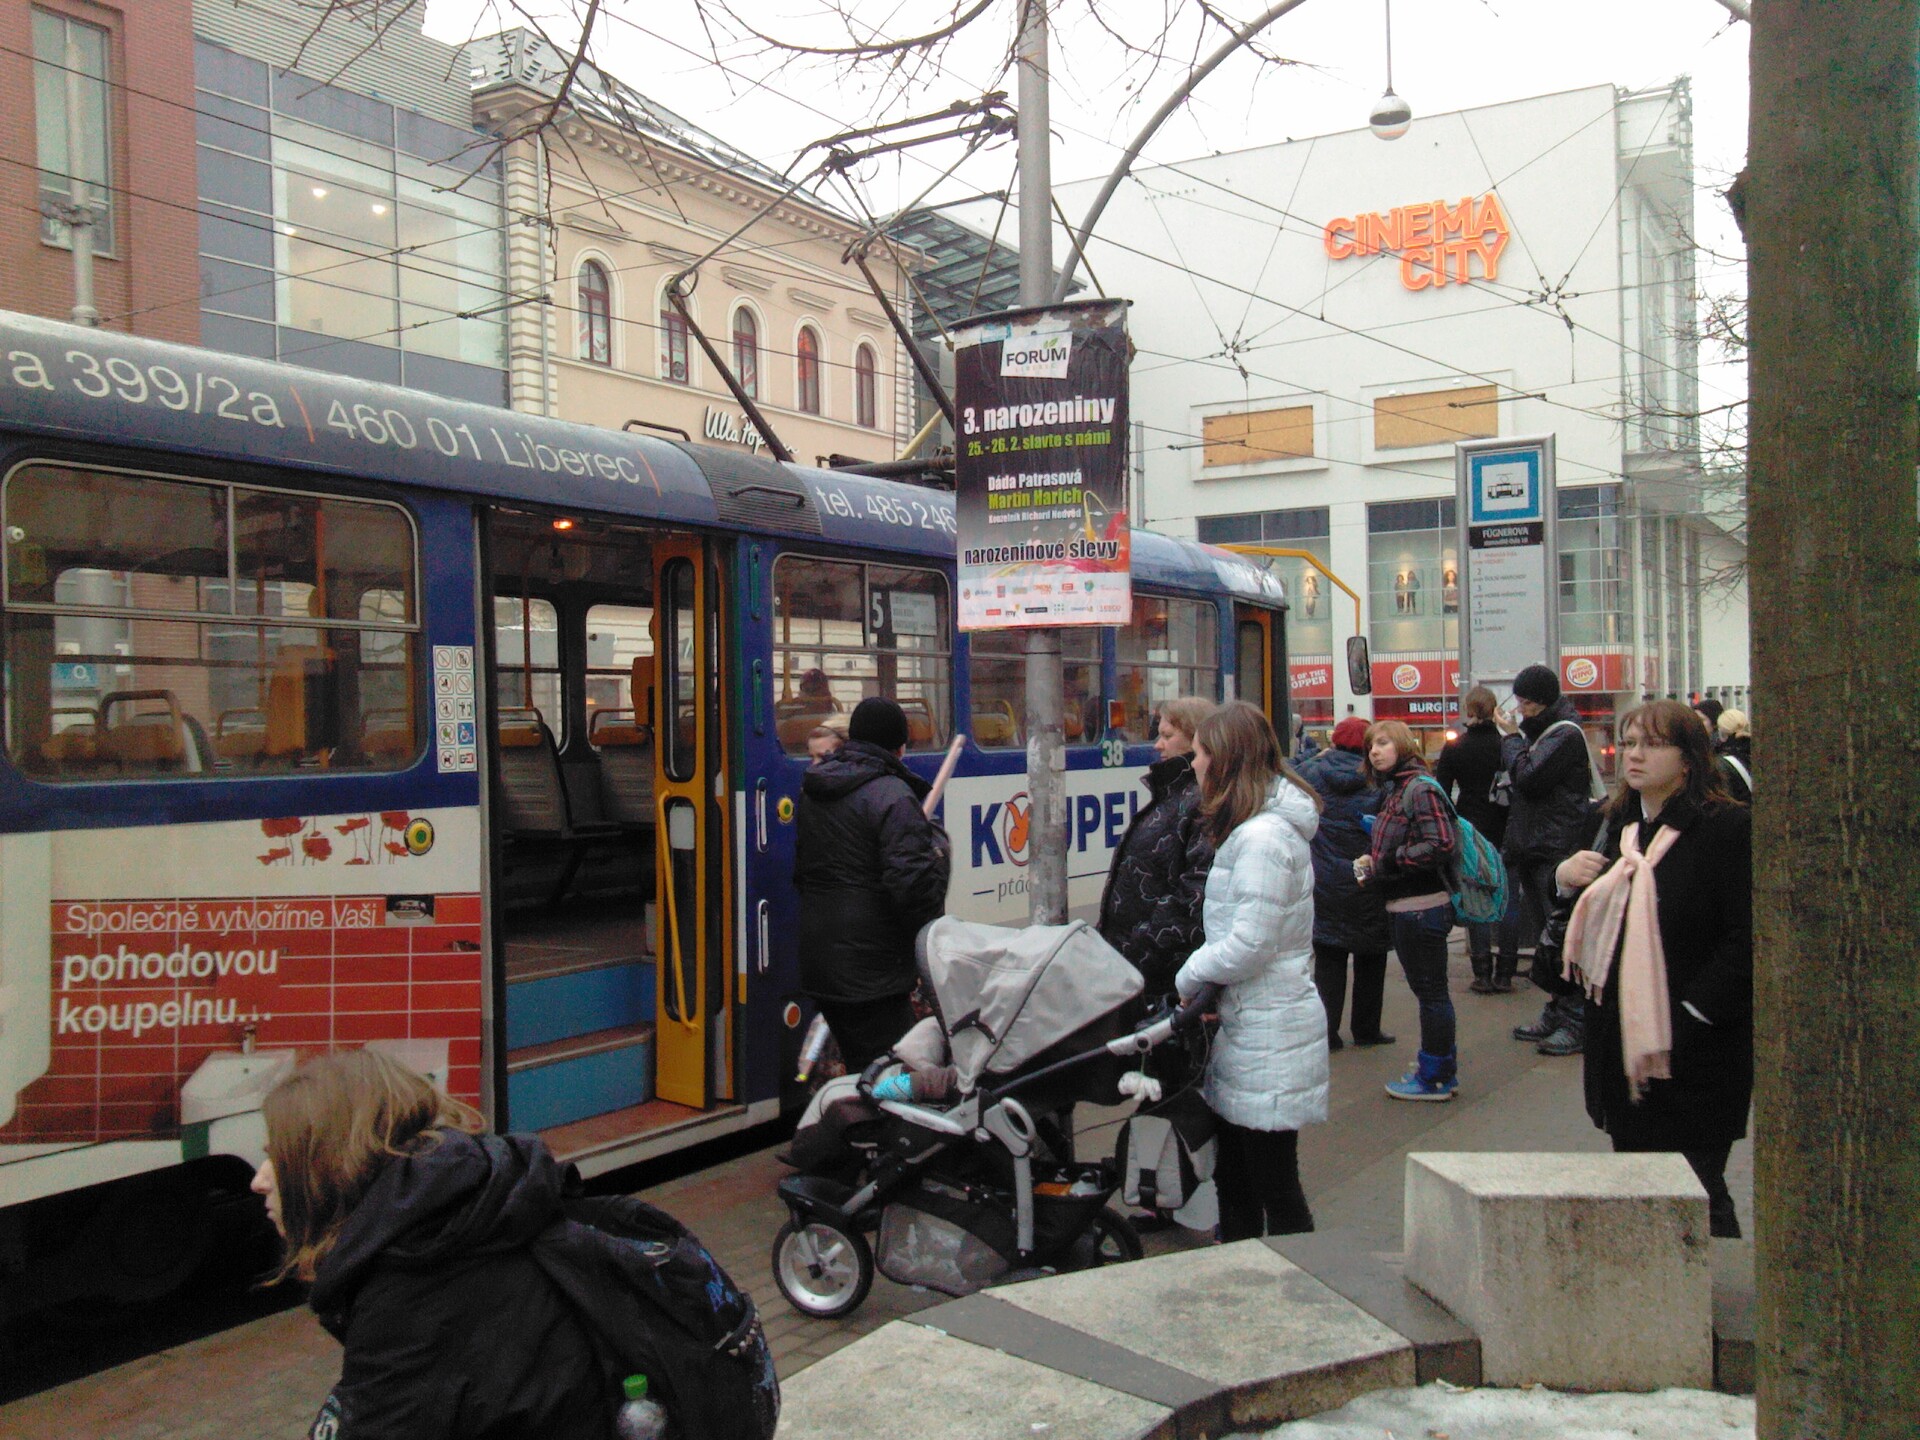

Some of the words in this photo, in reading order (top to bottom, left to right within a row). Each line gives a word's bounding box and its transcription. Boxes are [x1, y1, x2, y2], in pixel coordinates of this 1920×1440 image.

[1323, 194, 1509, 260] CINEMA
[1400, 231, 1509, 291] CITY
[1006, 347, 1067, 366] FORUM
[704, 403, 739, 443] Ulla
[963, 407, 980, 435] 3.
[983, 395, 1115, 432] narozeniny
[65, 350, 285, 429] 399/2a
[327, 399, 417, 449] 460
[426, 417, 482, 461] 01
[490, 427, 640, 484] Liberec
[815, 486, 862, 519] tel.
[867, 494, 913, 526] 485
[912, 501, 958, 534] 246
[968, 440, 984, 457] 25.
[1022, 433, 1062, 450] slavte
[1065, 435, 1073, 446] s
[1075, 429, 1111, 446] námi
[988, 474, 1016, 491] Dáda
[1018, 468, 1083, 488] Patrasová
[988, 491, 1031, 510] Martin
[964, 539, 1065, 565] narozeninové
[1069, 538, 1119, 560] slevy
[872, 592, 884, 628] 5
[1102, 740, 1124, 767] 38
[65, 904, 200, 938] Společně
[206, 903, 324, 937] vytvoříme
[332, 901, 377, 929] Vaši
[61, 943, 279, 991] pohodovou
[58, 992, 272, 1038] koupelnu...
